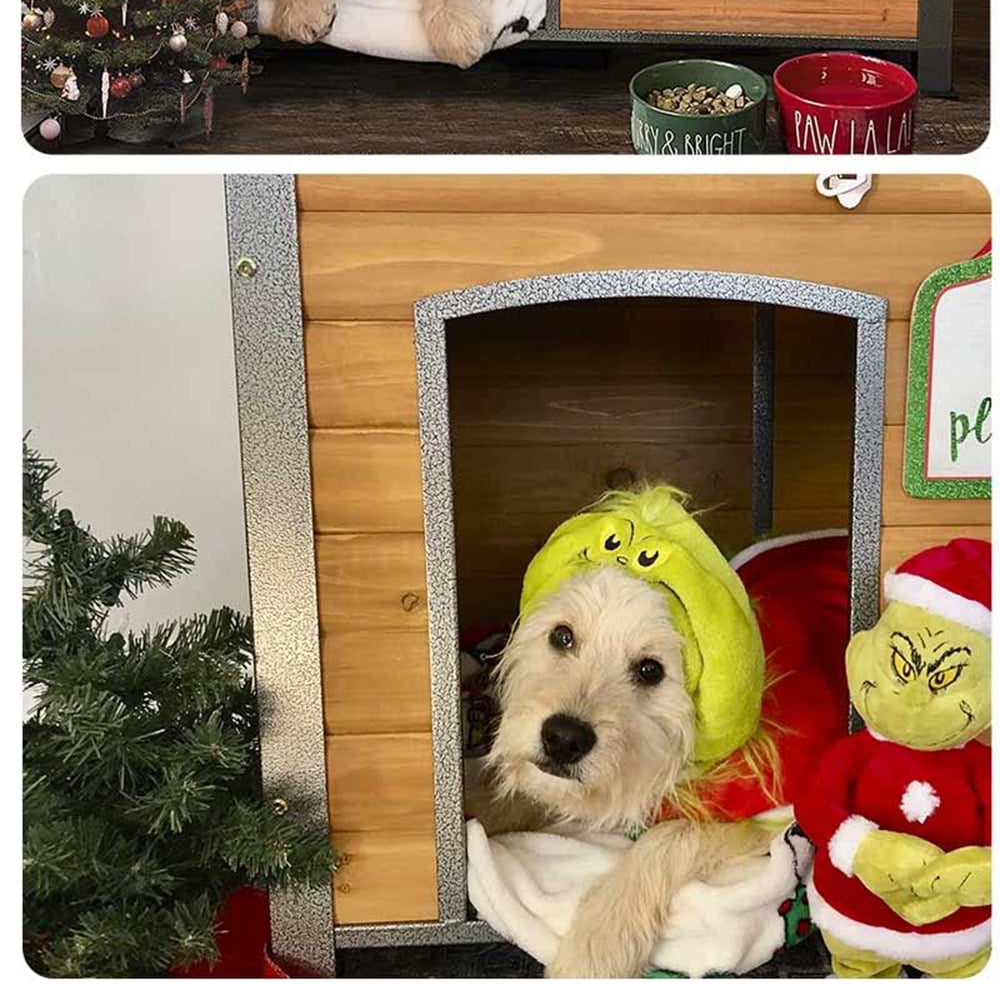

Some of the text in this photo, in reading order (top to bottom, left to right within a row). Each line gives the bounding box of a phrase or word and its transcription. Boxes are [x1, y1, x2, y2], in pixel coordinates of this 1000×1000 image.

[661, 129, 679, 155] &
[684, 127, 747, 155] BRIGHT
[794, 109, 839, 155] PAW
